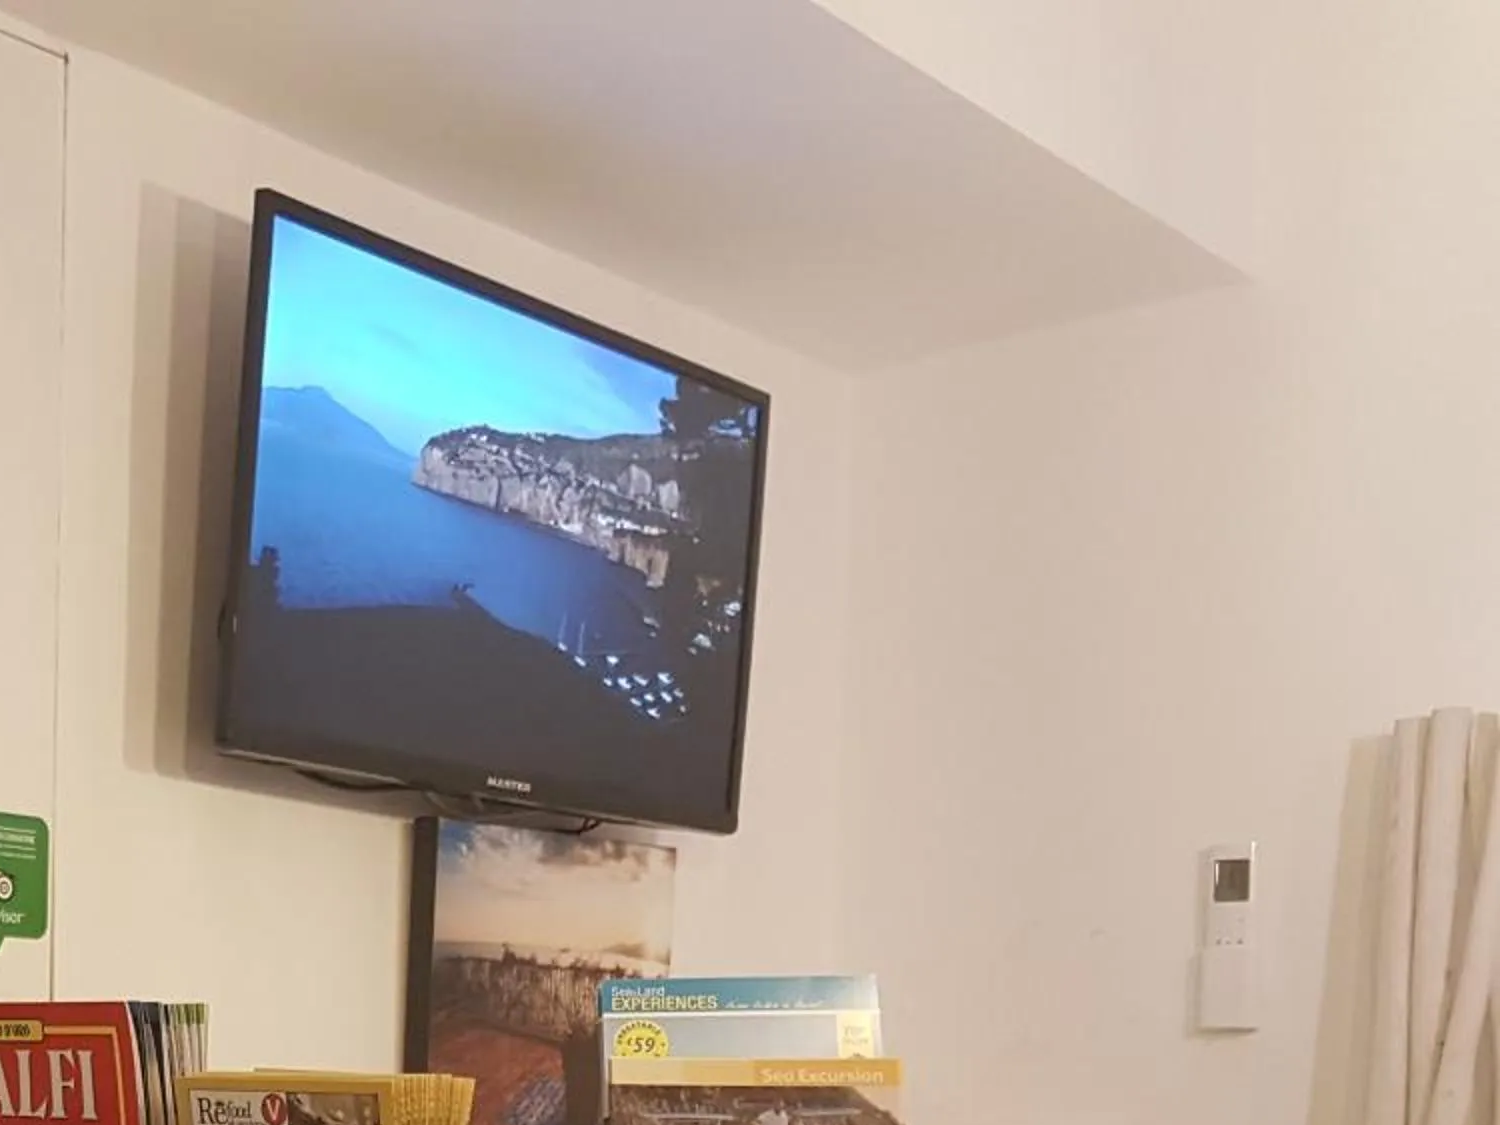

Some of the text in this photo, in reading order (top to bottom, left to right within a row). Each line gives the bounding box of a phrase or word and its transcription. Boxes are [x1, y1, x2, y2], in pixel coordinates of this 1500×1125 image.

[612, 995, 717, 1011] EXPERIENCES
[760, 1068, 884, 1084] Sea Excursion
